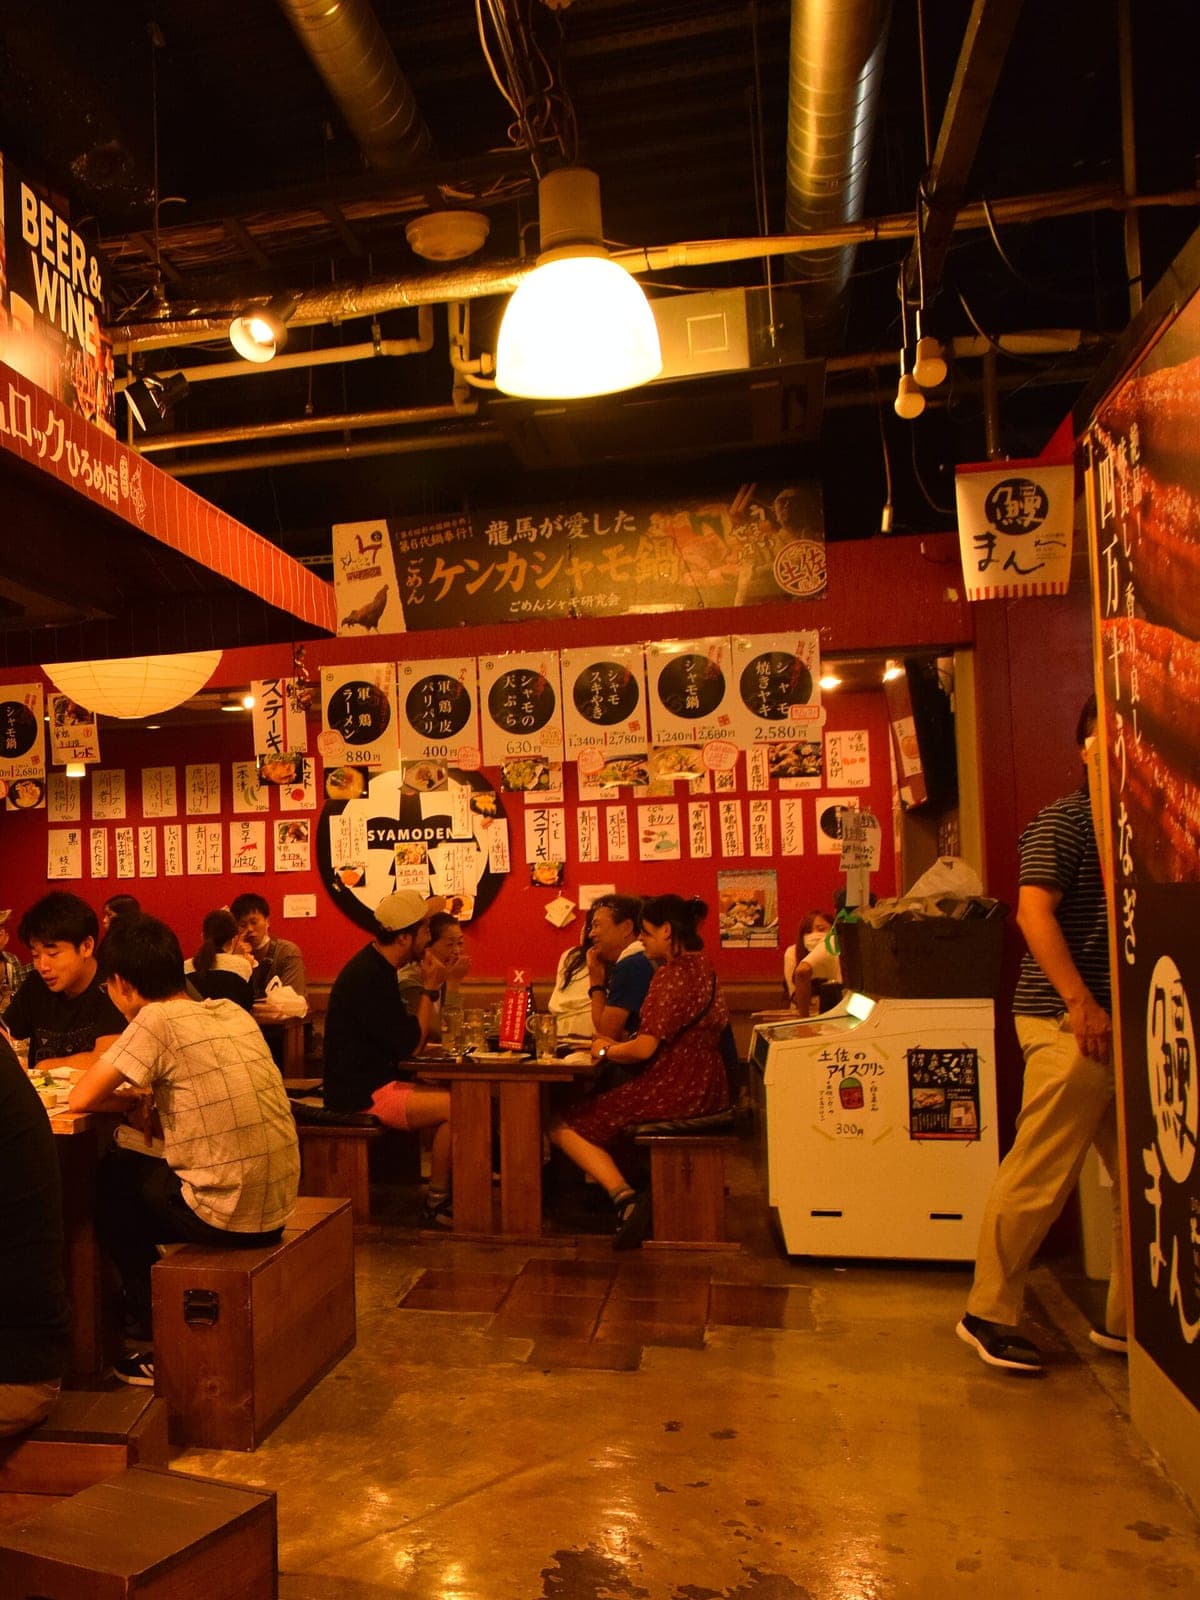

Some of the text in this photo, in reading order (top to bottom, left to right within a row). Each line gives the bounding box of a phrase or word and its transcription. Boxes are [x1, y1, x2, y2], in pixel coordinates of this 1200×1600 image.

[21, 182, 102, 300] BEER &
[31, 251, 99, 358] WINE
[66, 440, 119, 505] ひろめ店
[485, 509, 637, 547] 龍馬が愛した
[429, 536, 680, 603] ケンカシャモ鍋
[973, 531, 1046, 576] まん
[406, 558, 426, 605] ごめん
[509, 592, 620, 613] ごめんシャモ研究会
[357, 687, 372, 728] 軍鶏
[421, 681, 436, 735] パリパリ
[438, 680, 453, 734] 軍鶏皮
[503, 674, 517, 727] 天ぷら
[520, 675, 535, 727] シャモの
[590, 671, 603, 720] スキやき
[607, 670, 621, 706] シャモ
[685, 660, 700, 710] シャモ鍋
[755, 660, 772, 718] 焼きヤキ
[775, 661, 790, 715] シャモ
[5, 706, 17, 750] シャモ鍋
[262, 678, 283, 753] ステーキ
[343, 688, 356, 740] ラーメン
[754, 726, 808, 740] 2,580円
[345, 750, 381, 764] 880円
[422, 745, 458, 758] 400円
[506, 741, 542, 755] 630円
[532, 809, 548, 862] ステーキ
[784, 800, 799, 855] アイスクリン
[817, 1047, 867, 1063] 土佐の
[826, 1063, 886, 1080] アイスクリン
[834, 1122, 865, 1137] 300円
[1142, 1141, 1200, 1346] まん
